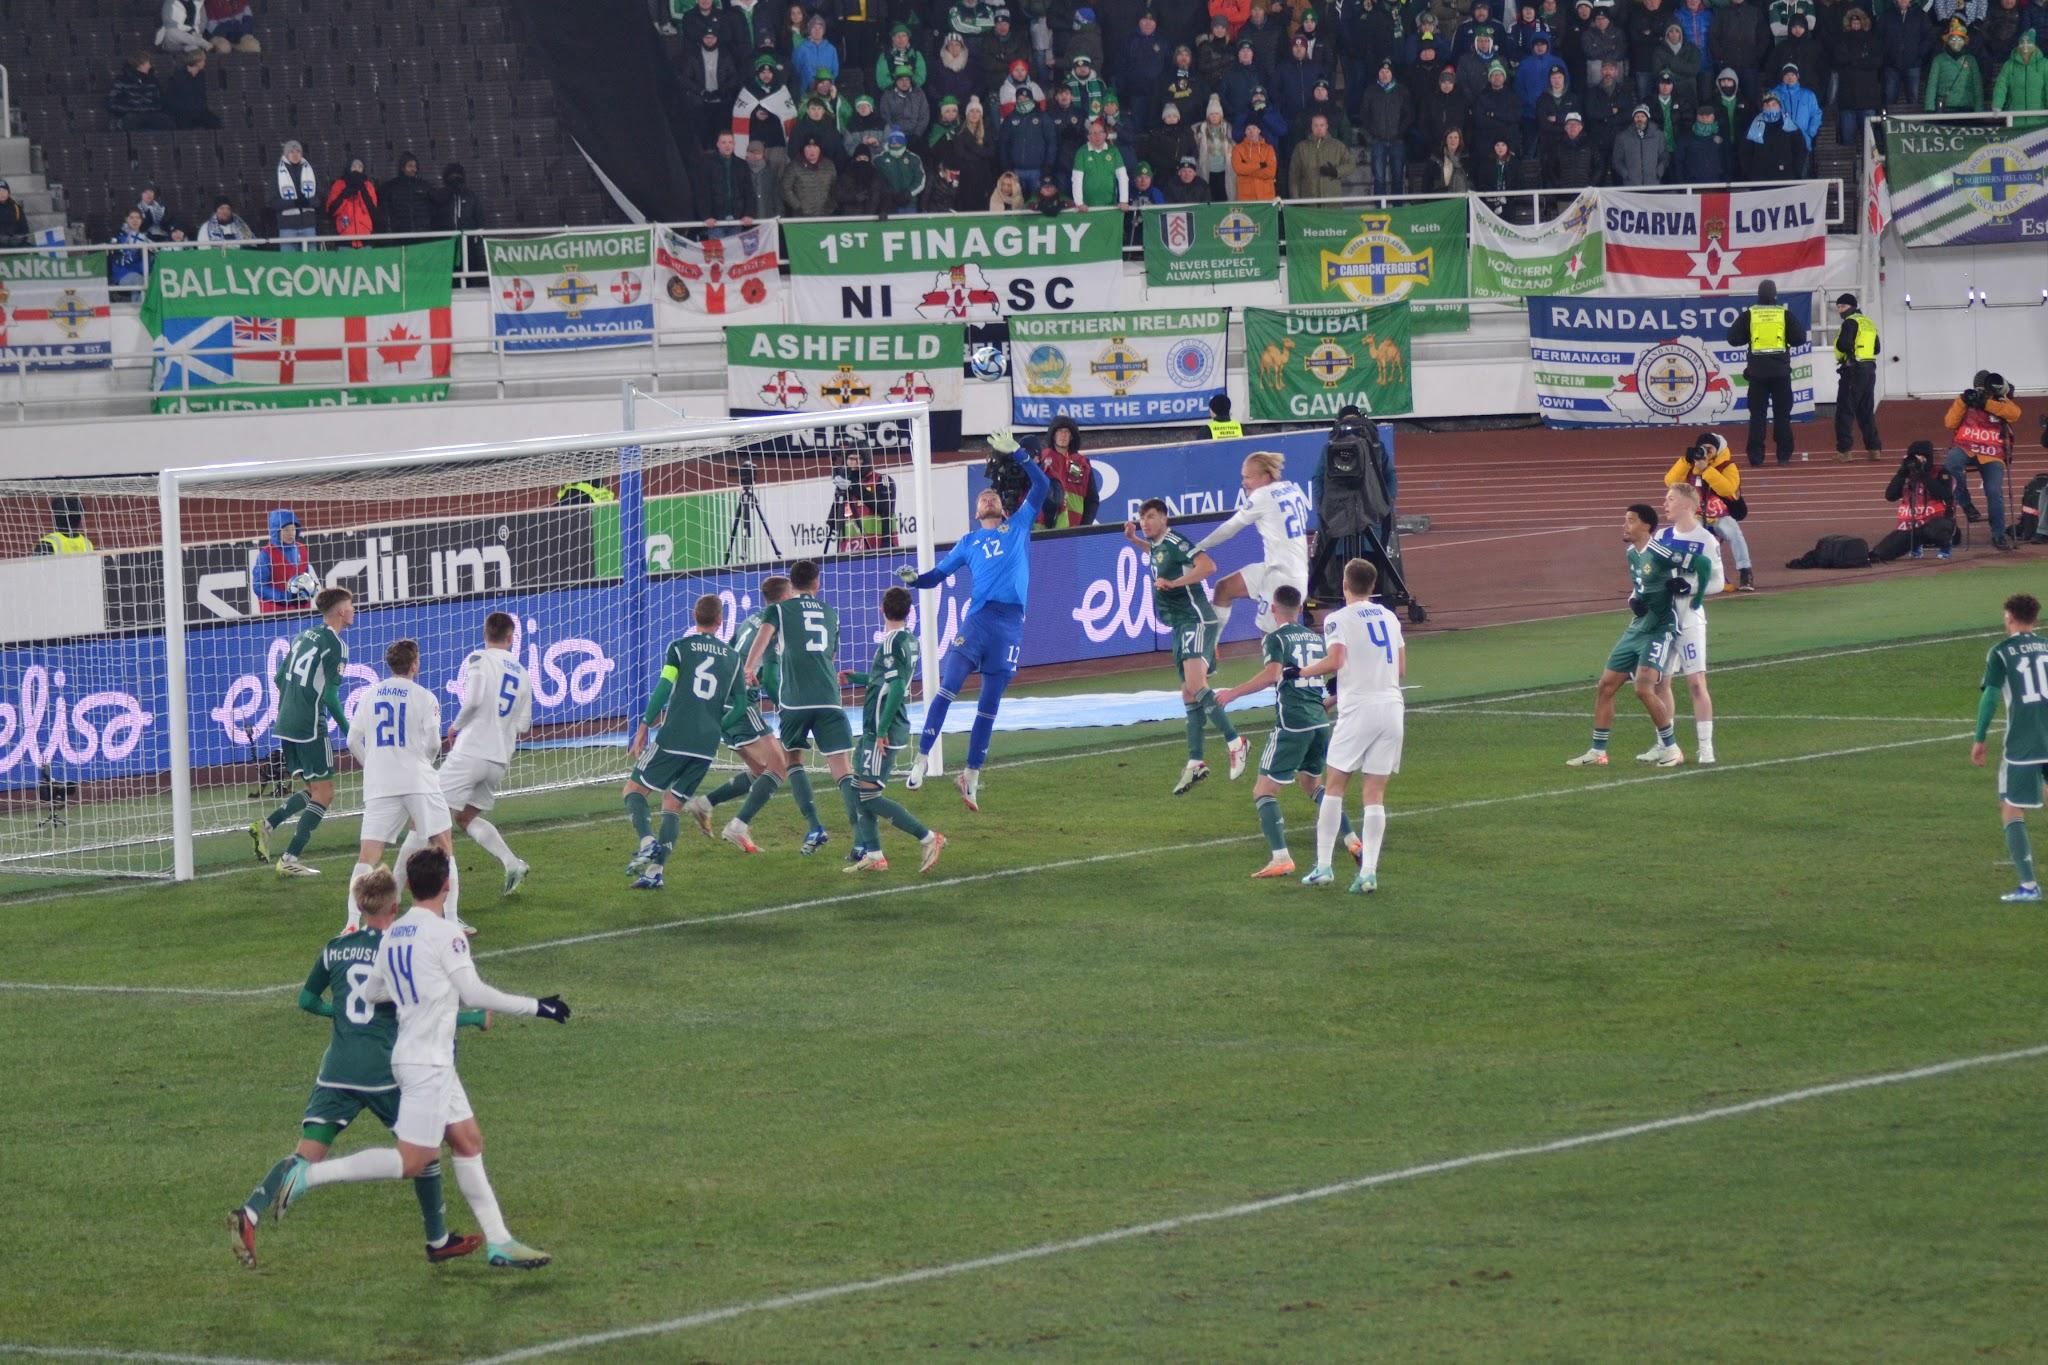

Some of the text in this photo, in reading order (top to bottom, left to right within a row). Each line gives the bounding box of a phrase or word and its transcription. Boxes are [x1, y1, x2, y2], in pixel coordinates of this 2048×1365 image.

[1964, 173, 2034, 185] NORTHERN IRELAND
[1410, 223, 1441, 234] Keith
[1606, 202, 1815, 236] SCARVA LOYAL
[819, 222, 1091, 264] 1ST FINAGHY
[1303, 228, 1348, 237] Heather
[494, 236, 646, 263] ANNAGHMORE
[1166, 268, 1262, 282] ALWAYS BELIEVE
[1170, 258, 1256, 271] NEVER EXPECT
[1339, 262, 1417, 276] CARRICKFERGUS
[1488, 258, 1553, 278] NORTHERN
[160, 262, 400, 300] BALLYGOWAN
[1501, 276, 1553, 290] IRELAND
[1016, 312, 1220, 336] NORTHERN IRELAND
[1286, 313, 1368, 335] DUBAI
[1551, 302, 1789, 331] RANDALSTO
[0, 345, 76, 366] NALS
[750, 332, 941, 361] ASHFIELD
[1533, 349, 1621, 364] FERMANAGH
[1535, 373, 1585, 386] ANTRIM
[1021, 397, 1212, 419] WE ARE THE PEOPL
[1290, 391, 1373, 416] GAWA
[1278, 496, 1307, 539] 20
[982, 539, 1005, 559] 12
[800, 601, 823, 610] TOAL
[802, 611, 829, 652] 5
[1181, 630, 1196, 650] 17
[1366, 620, 1393, 664] 4
[690, 642, 728, 657] SAVILLE
[1683, 642, 1697, 661] 16
[285, 640, 319, 688] 14
[692, 656, 718, 700] 6
[499, 672, 519, 718] 5
[374, 701, 407, 748] 21
[863, 750, 873, 769] 2
[388, 944, 420, 1006] 14
[346, 963, 376, 1025] 8
